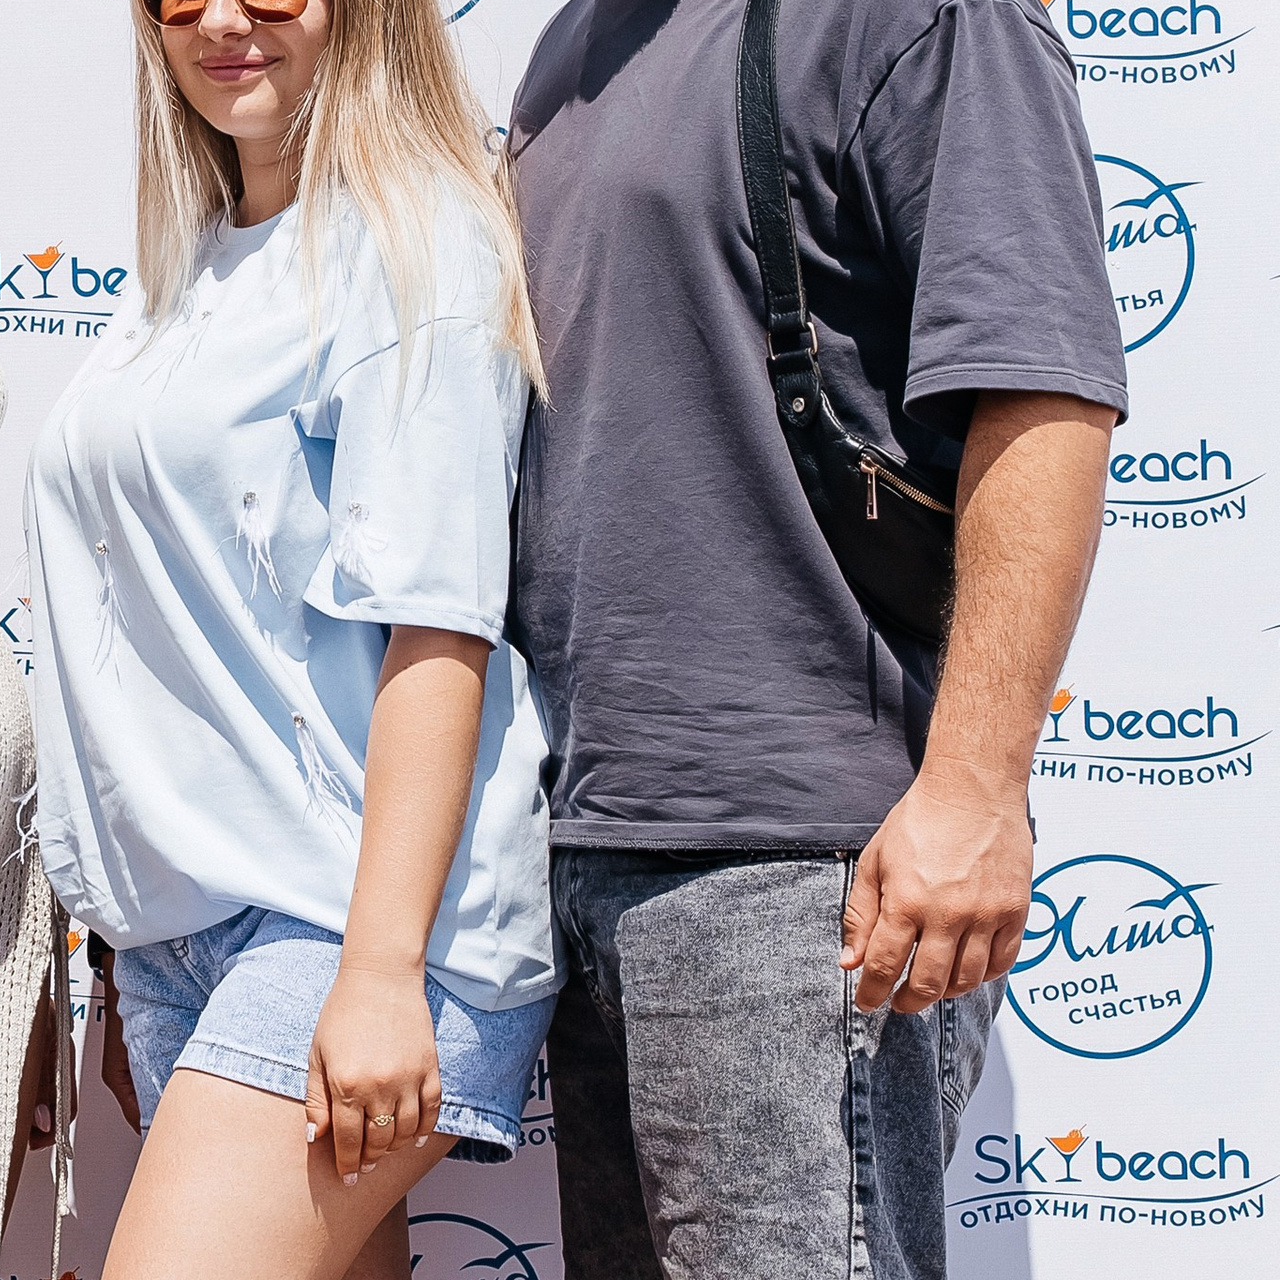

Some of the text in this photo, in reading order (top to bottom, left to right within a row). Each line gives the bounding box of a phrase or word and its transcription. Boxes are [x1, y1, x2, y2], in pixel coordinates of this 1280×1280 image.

[1109, 438, 1232, 484] each
[1103, 495, 1246, 529] о-новому
[1083, 696, 1239, 742] beach
[1028, 973, 1119, 1006] город
[1067, 986, 1182, 1025] счастья
[1095, 1137, 1250, 1182] beach
